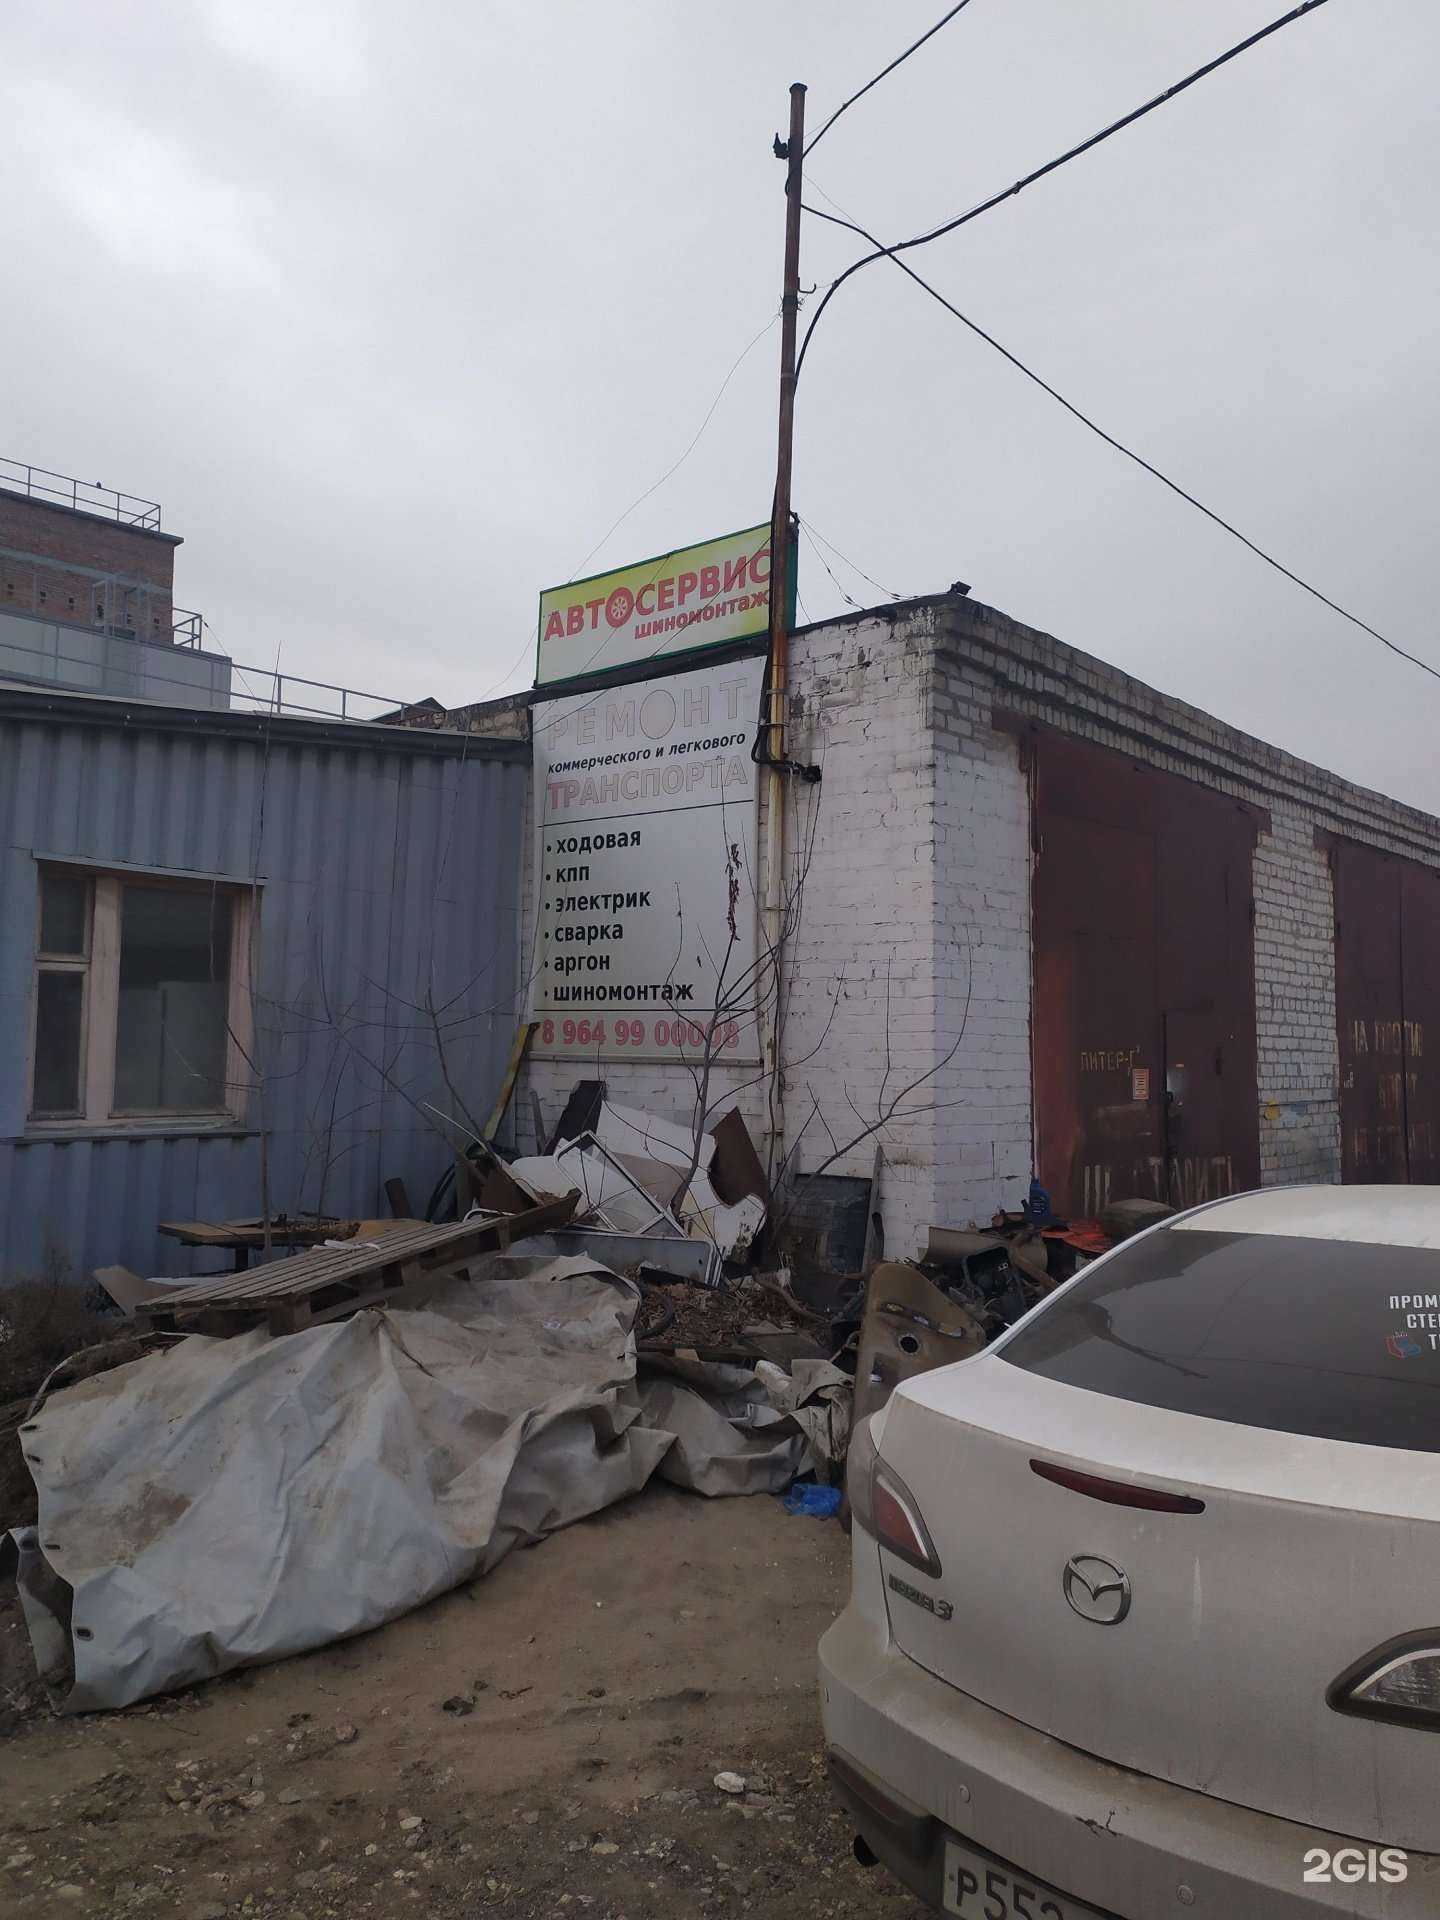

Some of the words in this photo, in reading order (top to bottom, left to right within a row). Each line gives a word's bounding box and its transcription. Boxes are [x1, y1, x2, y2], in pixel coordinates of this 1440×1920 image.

[544, 549, 772, 641] АВТОСЕРВИС
[548, 678, 748, 751] РЕМОНТ
[548, 748, 651, 775] коммерческого
[655, 745, 665, 758] и
[669, 733, 746, 756] легкового
[548, 754, 748, 810] ТРАНСПОРТА
[556, 830, 641, 855] ходовая
[555, 890, 651, 914] электрик
[554, 922, 624, 945] сварка
[553, 953, 611, 976] аргон
[553, 982, 694, 1001] шиномонтаж
[542, 1018, 555, 1045] 8
[562, 1018, 607, 1046] 964
[614, 1019, 646, 1047] 99
[1389, 1294, 1440, 1309] ПРОМ
[1406, 1313, 1440, 1329] СТЕ
[1428, 1333, 1440, 1350] Т
